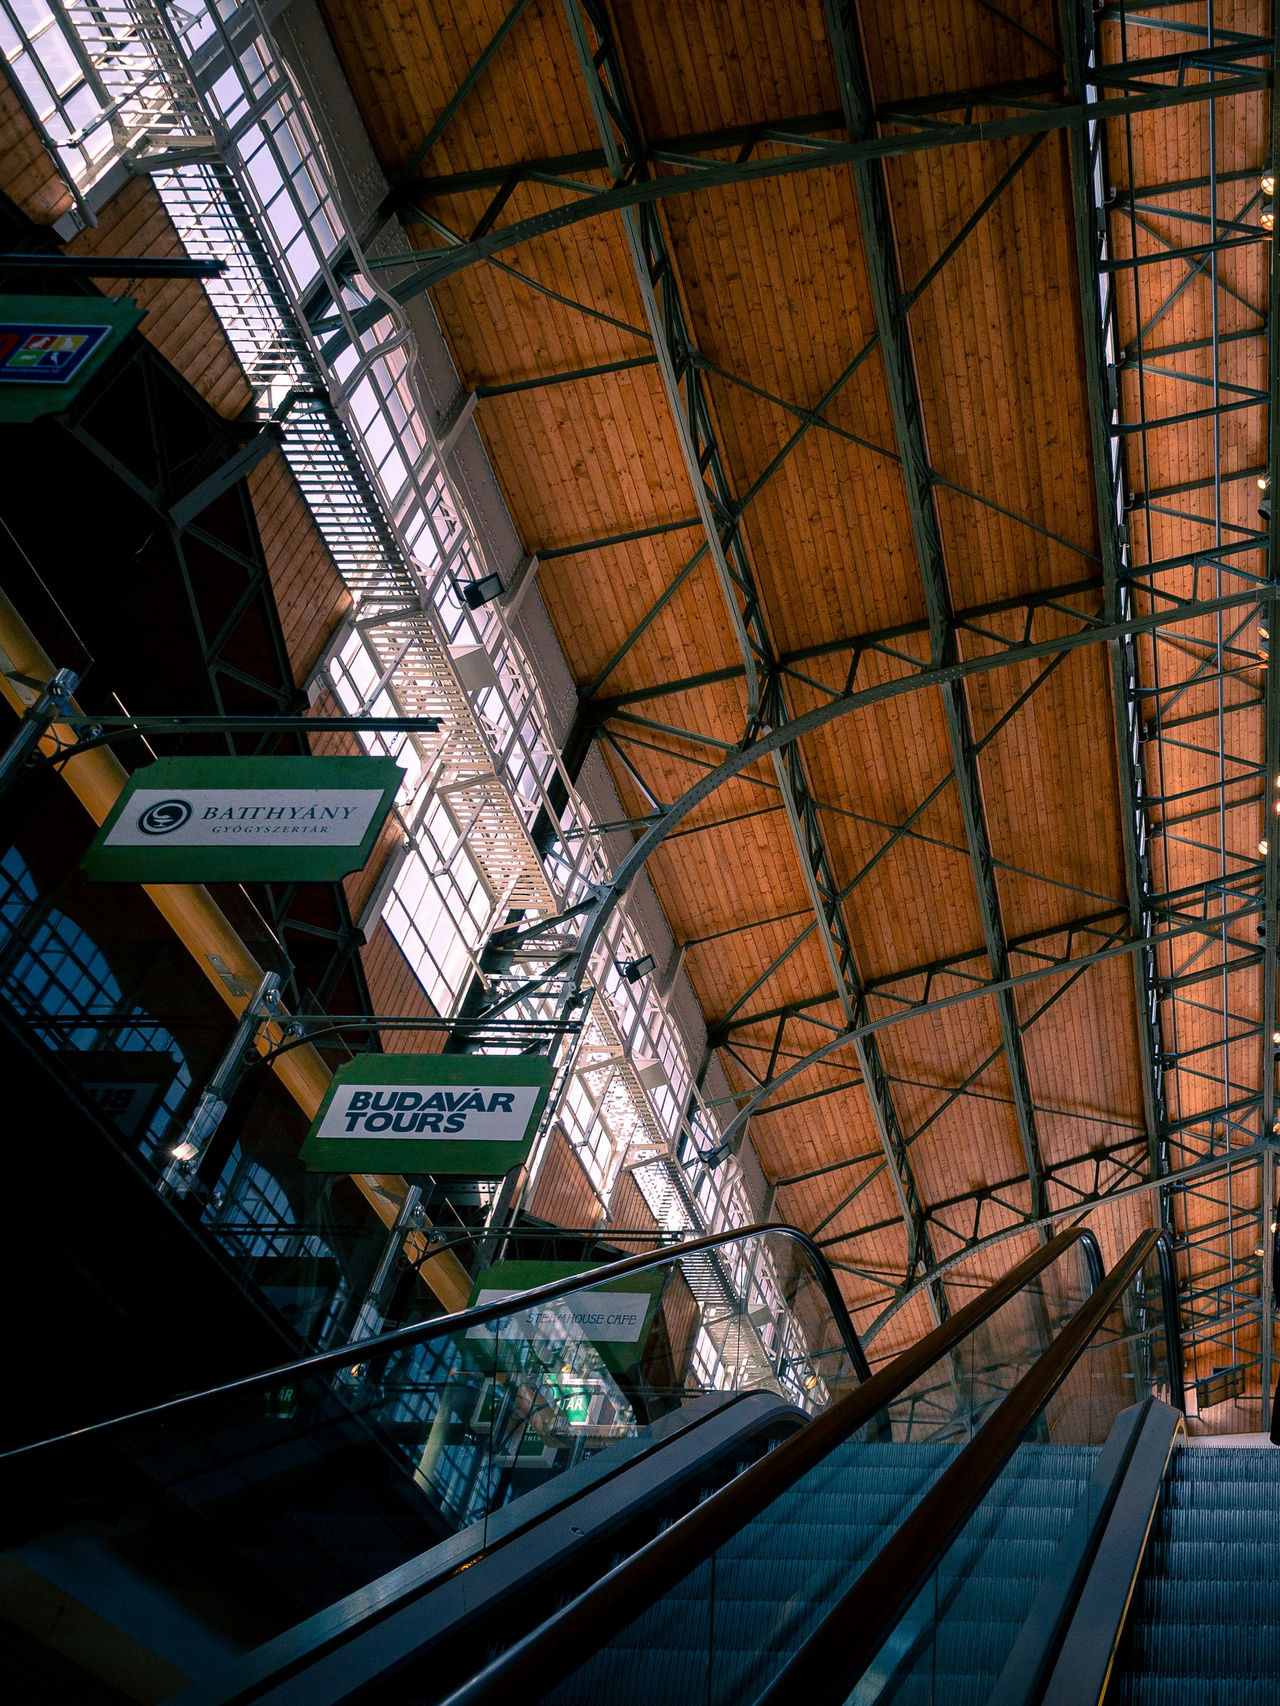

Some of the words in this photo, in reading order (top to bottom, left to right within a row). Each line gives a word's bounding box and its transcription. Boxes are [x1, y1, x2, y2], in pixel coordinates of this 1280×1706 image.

[201, 804, 358, 820] BATTHYÁNY
[212, 824, 329, 833] GYÓGYSZERTÁR
[347, 1088, 516, 1113] BUDAVÁR
[344, 1112, 467, 1133] TOURS
[526, 1313, 604, 1325] STEAMHOUSE
[606, 1314, 637, 1325] CAFE
